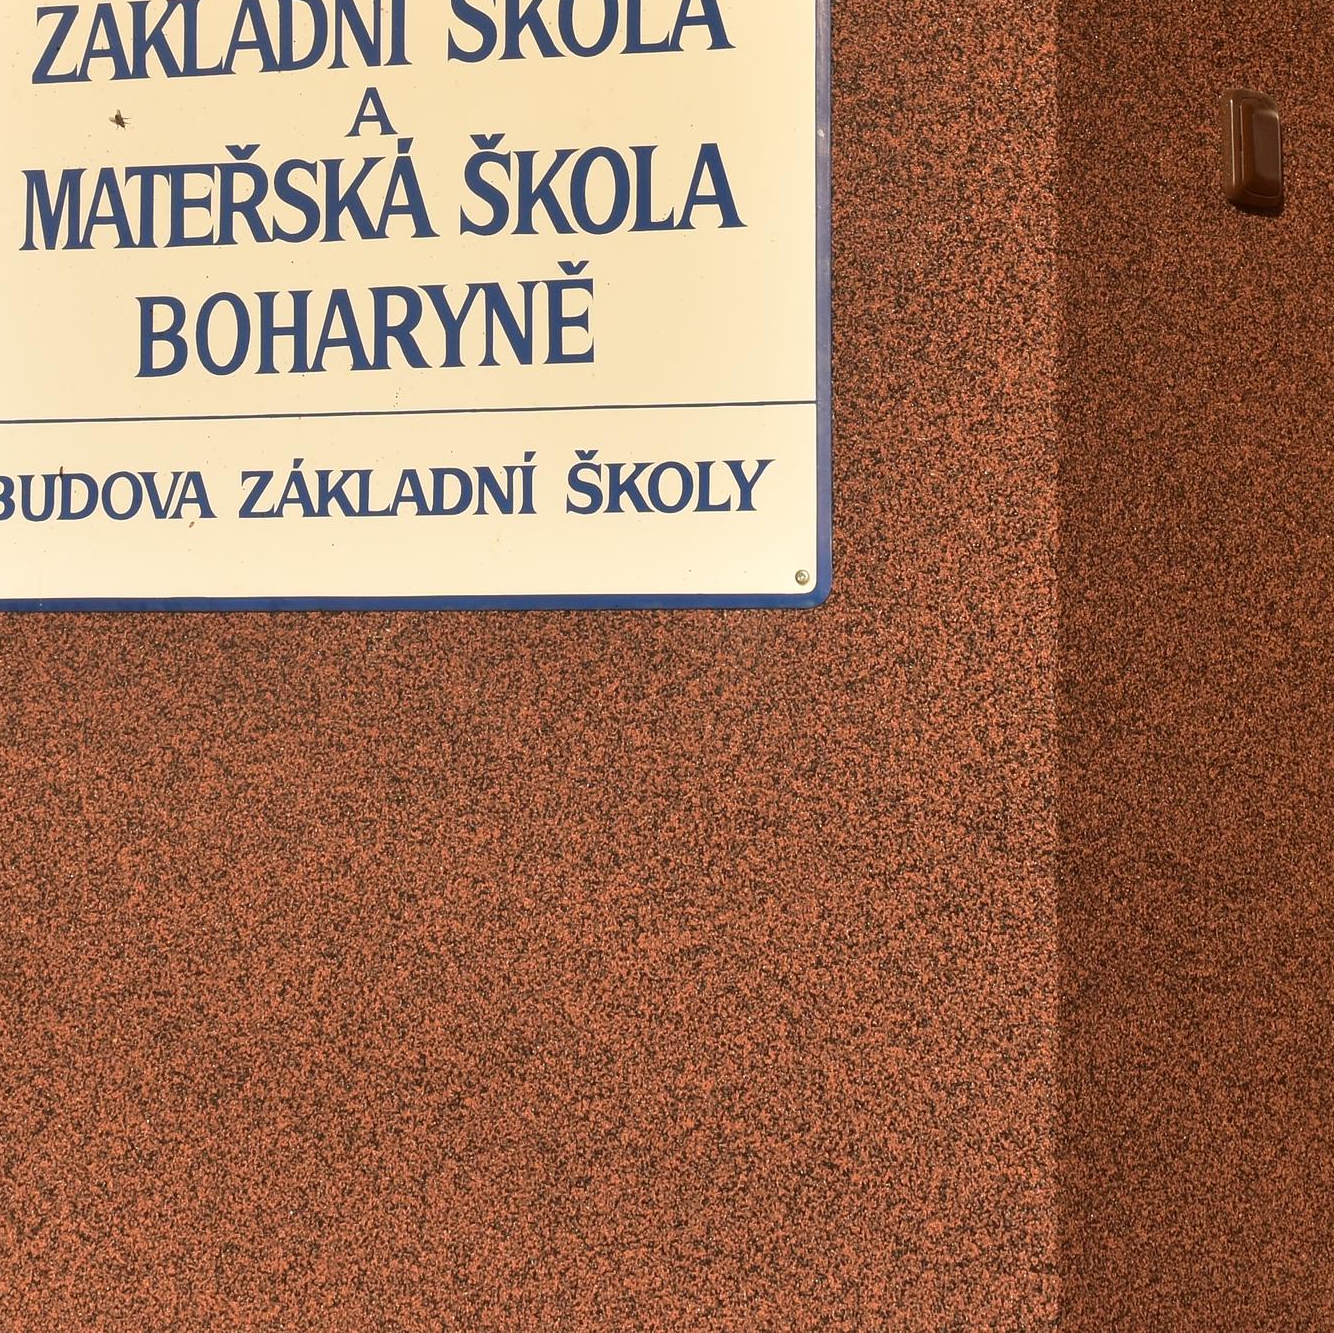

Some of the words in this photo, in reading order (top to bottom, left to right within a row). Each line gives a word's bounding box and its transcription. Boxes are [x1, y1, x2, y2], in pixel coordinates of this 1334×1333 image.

[345, 86, 399, 138] A
[18, 137, 441, 251] MATEŘSKÁ
[459, 133, 748, 237] ŠKOLA
[134, 260, 595, 378] BOHARYNĚ
[238, 450, 537, 519] ZÁKLADNÍ
[566, 449, 775, 515] ŠKOLY
